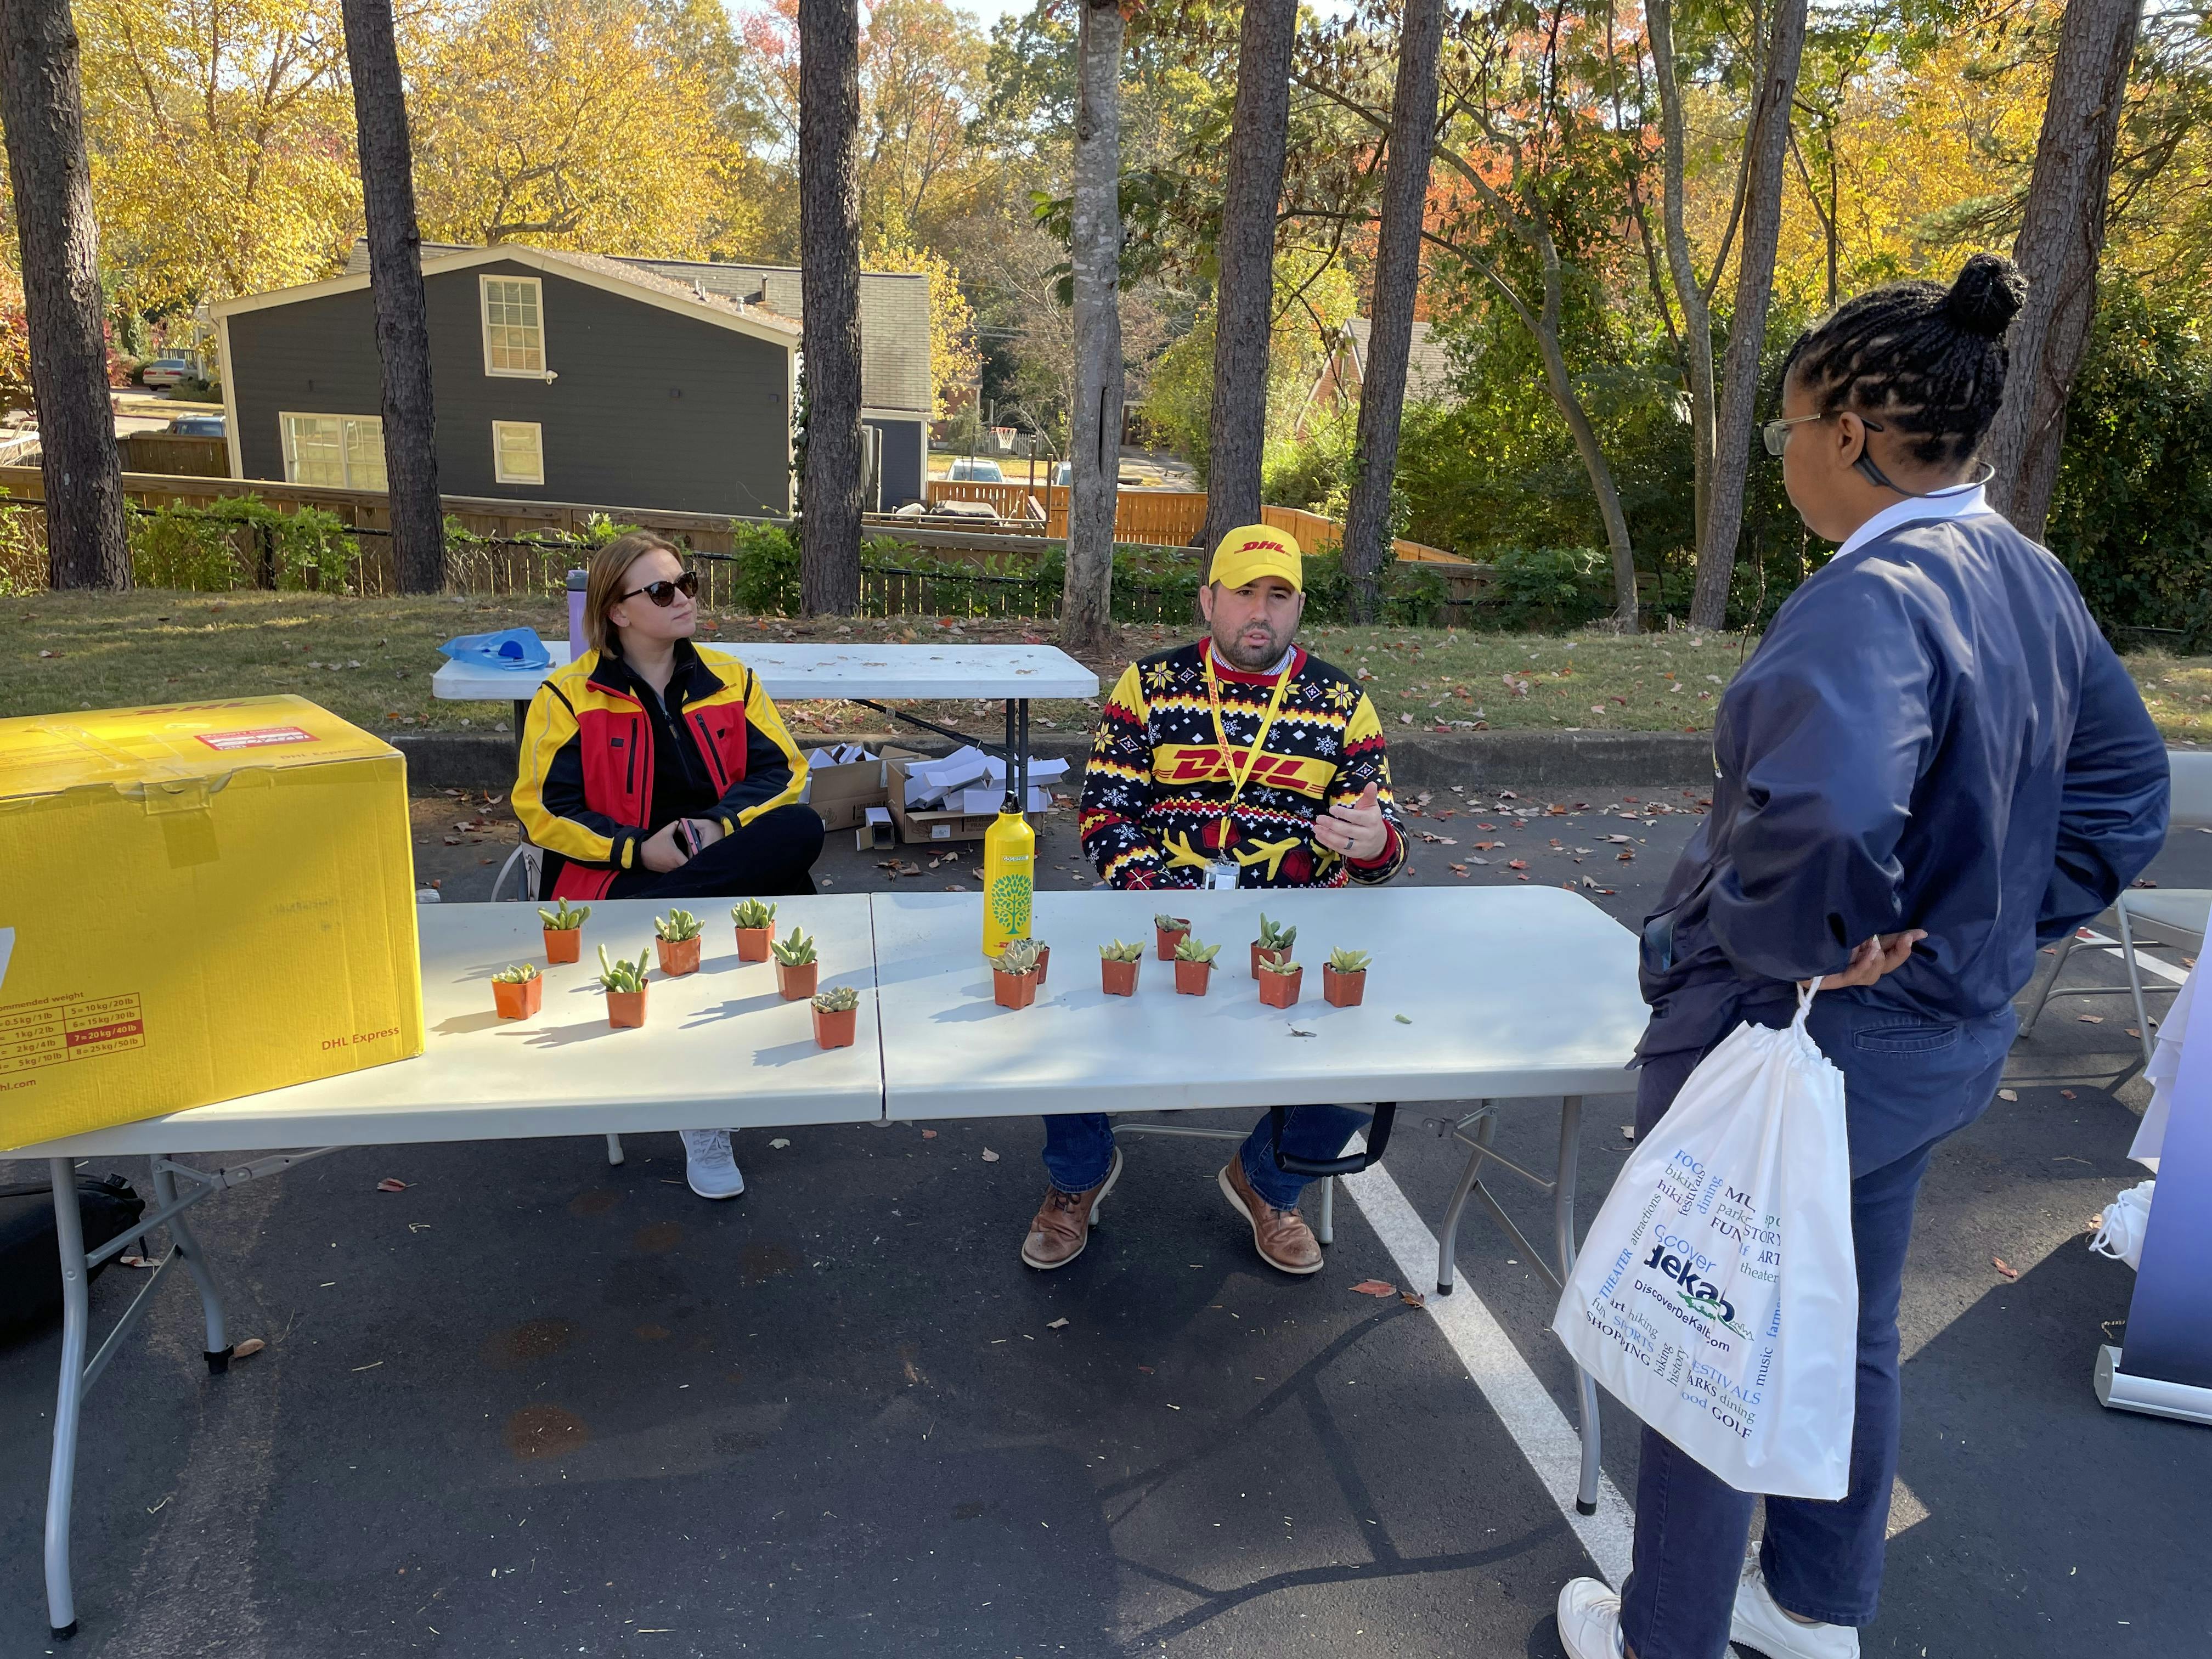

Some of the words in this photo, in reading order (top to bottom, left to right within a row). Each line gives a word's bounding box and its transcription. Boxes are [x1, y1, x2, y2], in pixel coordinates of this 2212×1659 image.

[1243, 541, 1285, 554] DHL
[134, 702, 247, 715] DHL
[1209, 680, 1218, 712] DHL
[1218, 735, 1233, 764] DHL
[1172, 749, 1309, 790] DHL
[52, 992, 84, 1002] weight
[322, 1037, 348, 1051] DHL
[353, 1026, 399, 1045] Express
[1697, 1176, 1724, 1215] dining
[1630, 1193, 1661, 1245] attractions
[1599, 1248, 1633, 1299] THEATER
[1740, 1262, 1779, 1283] theater
[1592, 1297, 1606, 1319] fun
[1628, 1308, 1658, 1340] hiking
[1586, 1311, 1651, 1366] SHOPPING
[1653, 1342, 1674, 1377] biking
[1667, 1345, 1689, 1387] history
[1756, 1347, 1773, 1387] music
[1712, 1406, 1753, 1440] GOLF
[1720, 1394, 1756, 1425] dining
